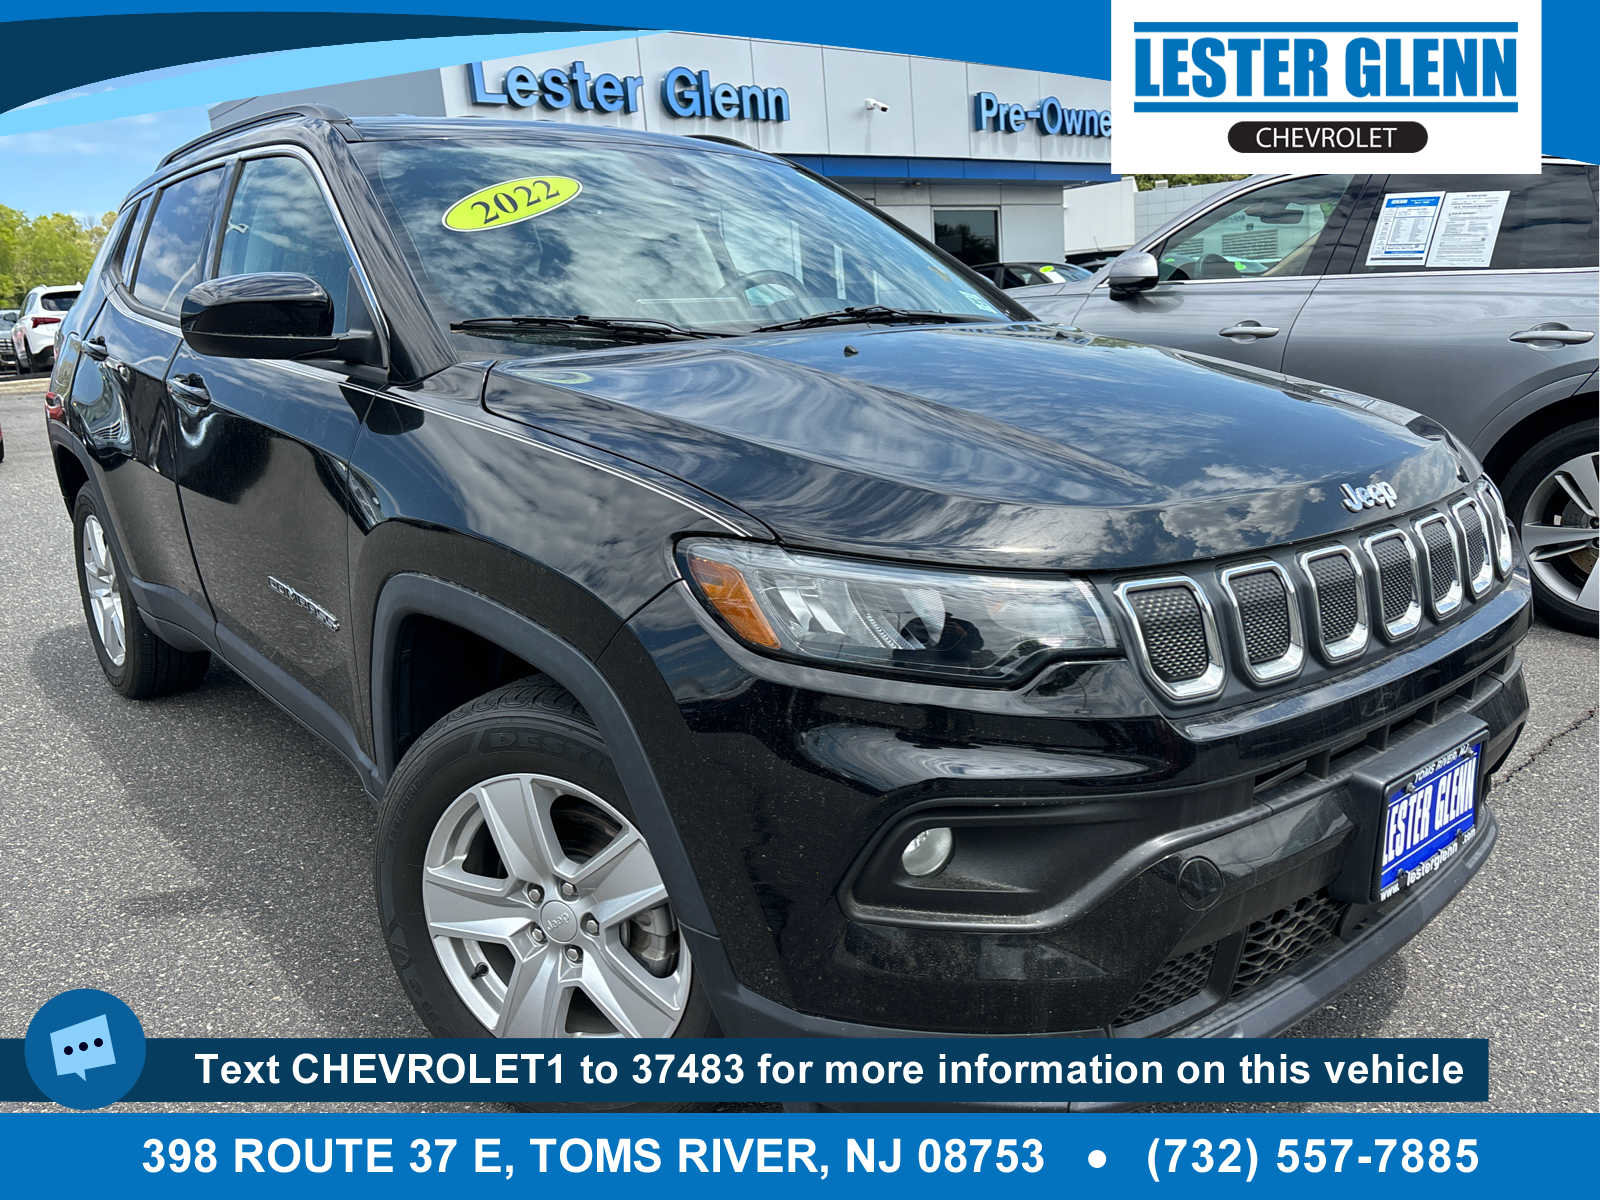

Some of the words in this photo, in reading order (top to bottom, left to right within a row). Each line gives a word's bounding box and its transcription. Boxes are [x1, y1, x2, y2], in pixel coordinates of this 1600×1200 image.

[469, 60, 644, 114] Lester
[661, 66, 791, 122] Glenn
[471, 180, 561, 225] 2022
[1339, 481, 1398, 512] Jeep
[1381, 784, 1433, 868] LESTER
[1434, 757, 1477, 831] GLENN
